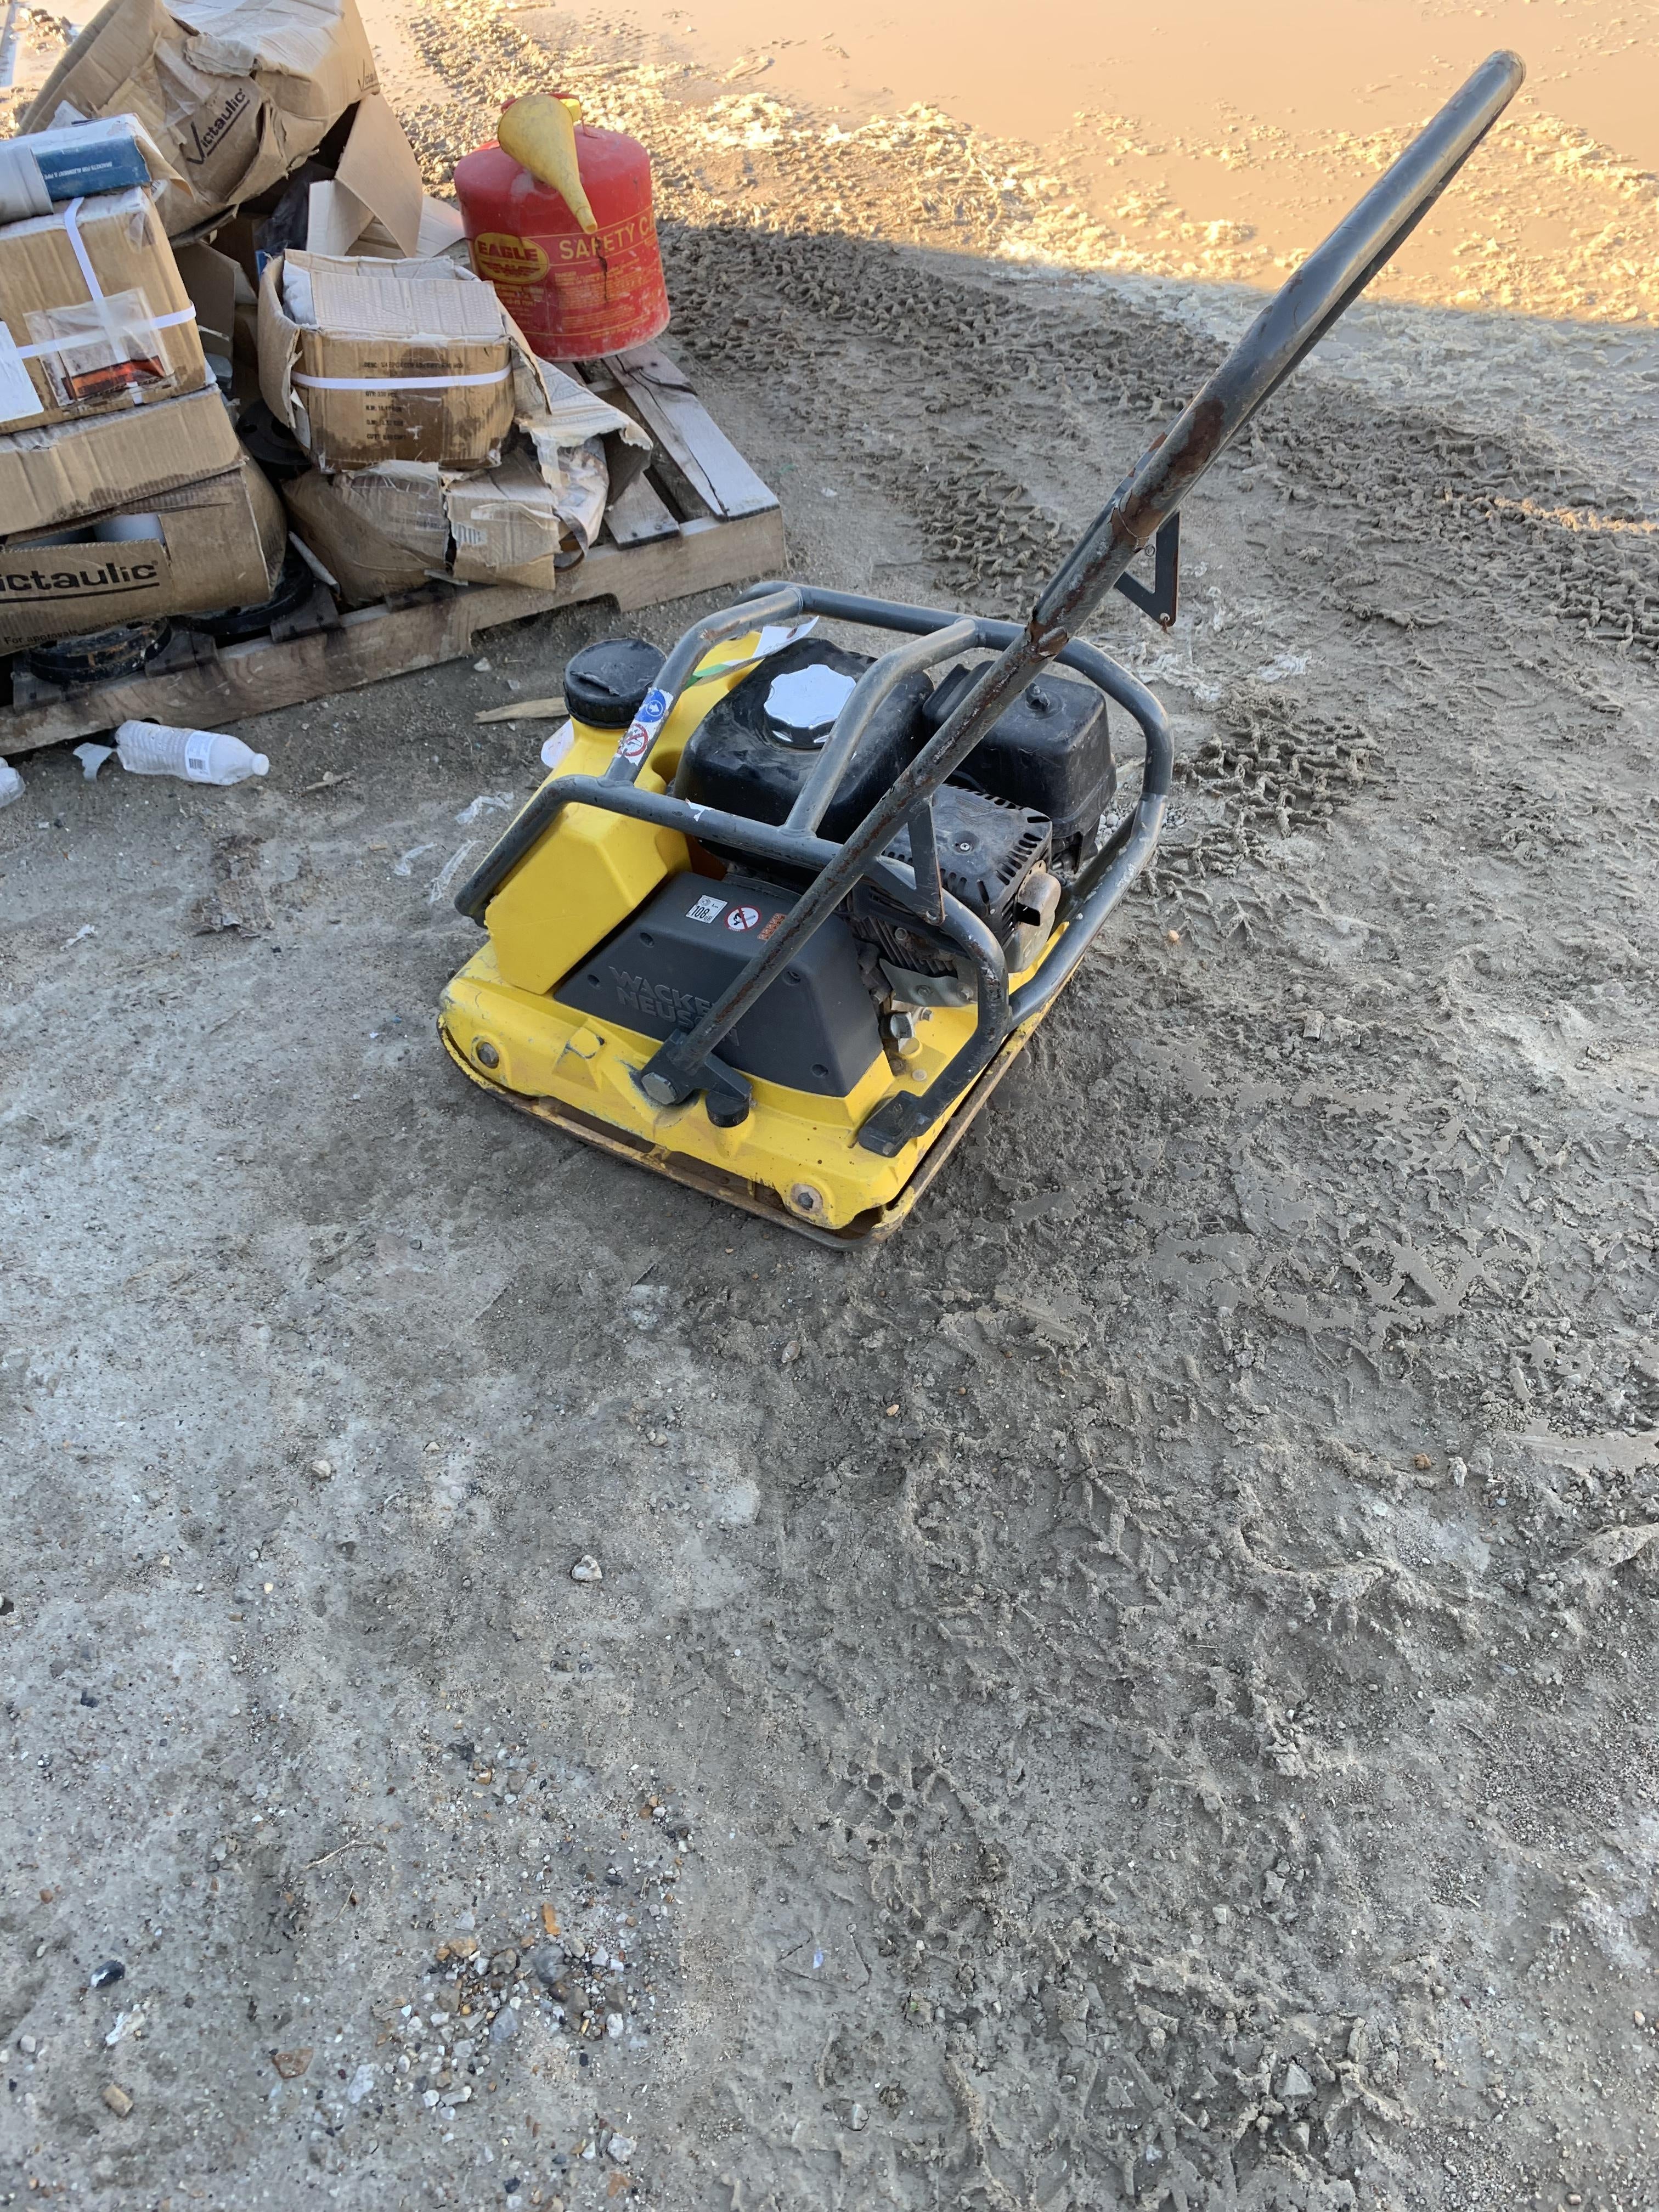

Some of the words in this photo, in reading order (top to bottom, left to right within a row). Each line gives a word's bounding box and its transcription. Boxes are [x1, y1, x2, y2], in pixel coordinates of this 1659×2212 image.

[477, 240, 539, 262] EAGLE
[559, 222, 635, 260] SAFETY
[4, 636, 22, 645] For
[691, 905, 710, 918] 108
[608, 966, 714, 1015] WACKE
